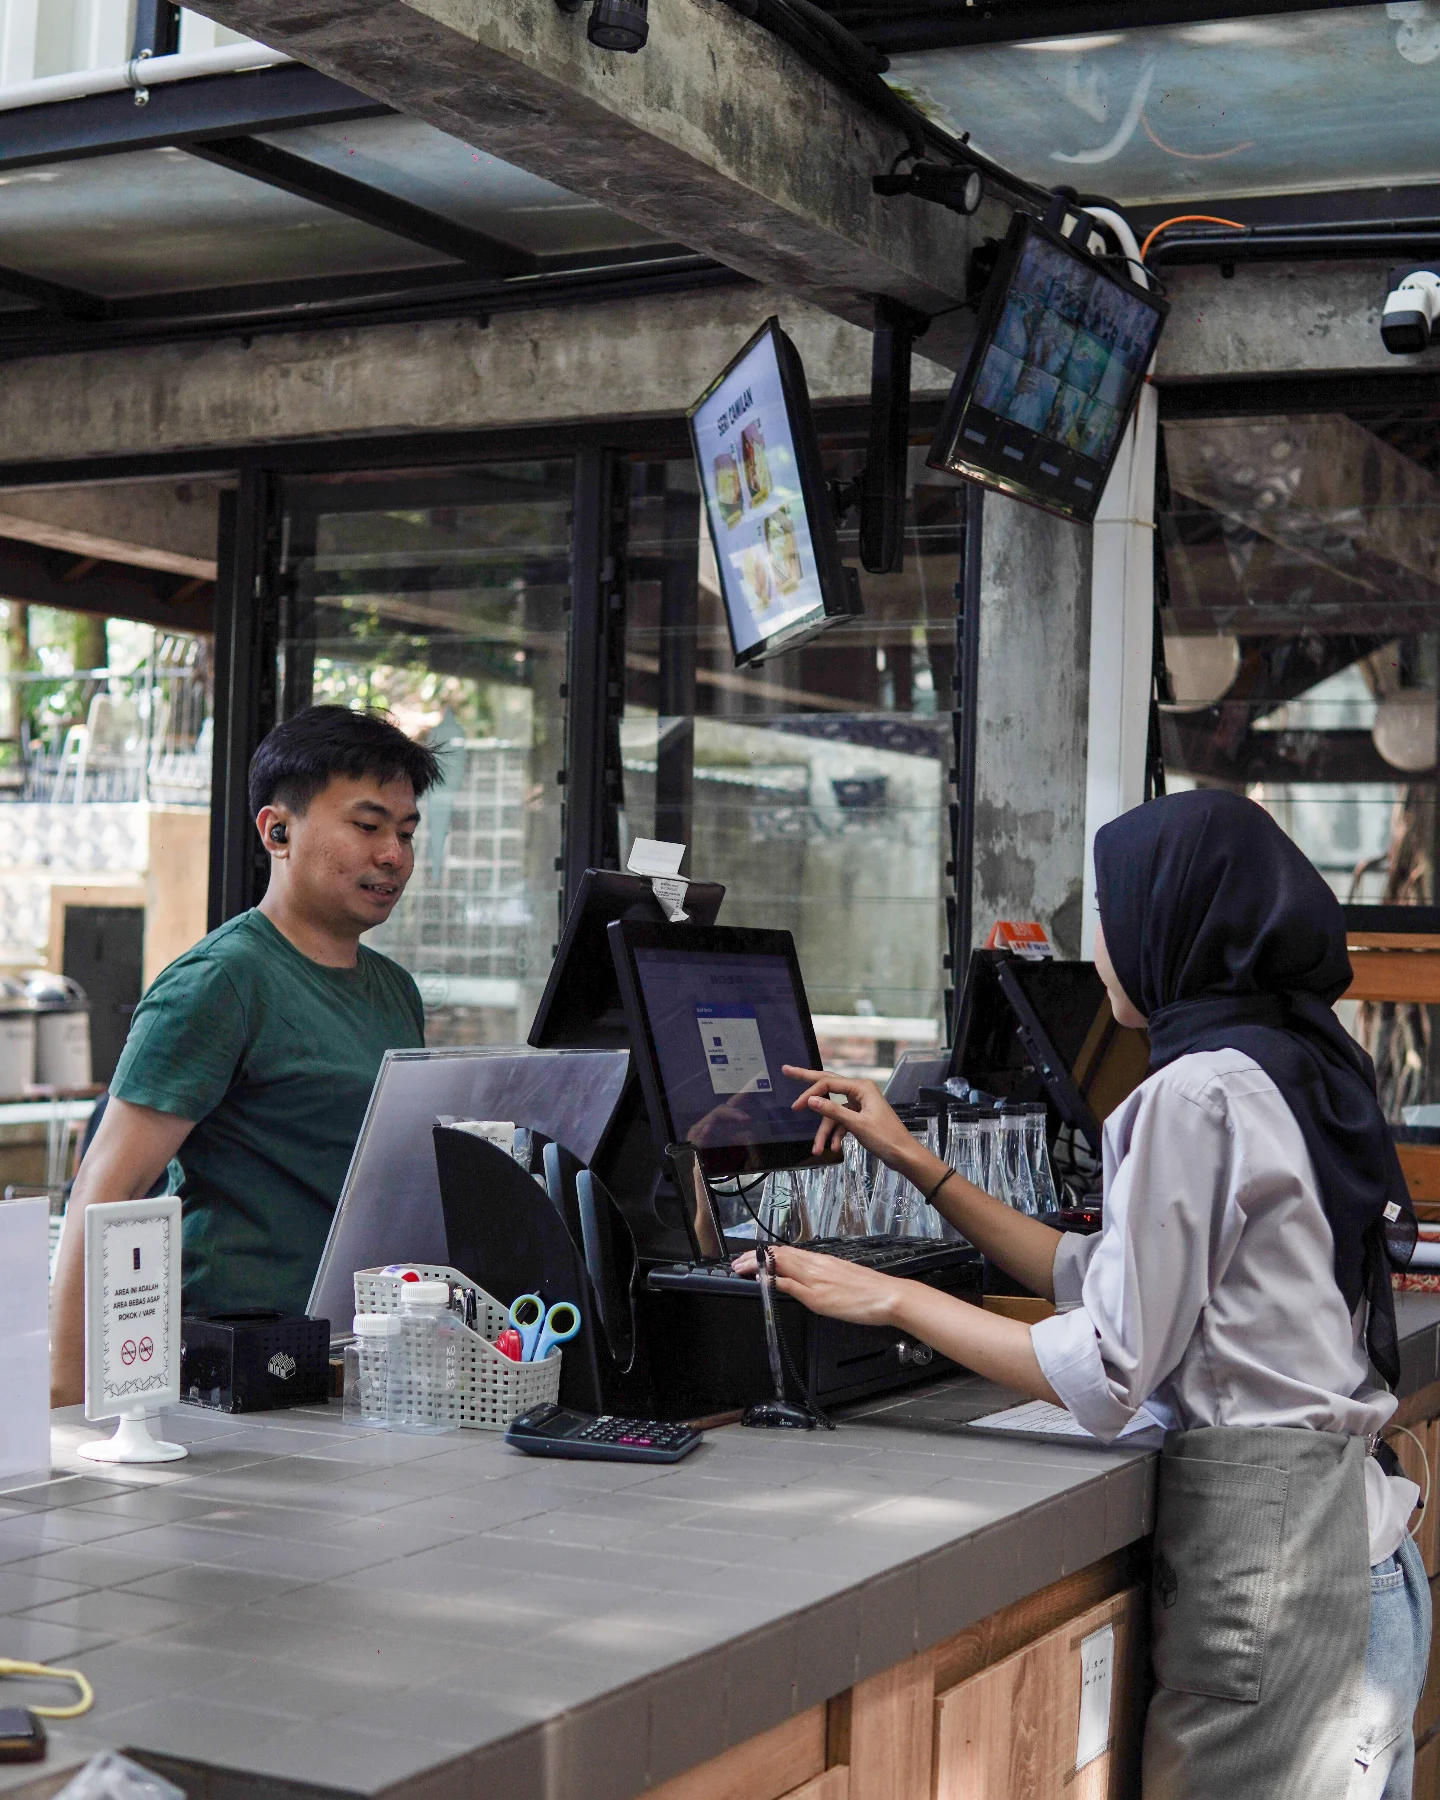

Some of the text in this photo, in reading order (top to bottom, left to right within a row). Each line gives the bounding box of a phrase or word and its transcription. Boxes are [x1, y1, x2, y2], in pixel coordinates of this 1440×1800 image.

[115, 1288, 129, 1296] AREA
[139, 1283, 159, 1292] ADALAH
[113, 1301, 127, 1309] AREA
[129, 1298, 146, 1306] BEBAS
[119, 1311, 137, 1321] ROKOK
[143, 1308, 156, 1317] VAPE
[447, 1345, 455, 1355] KO
[446, 1380, 455, 1390] KO
